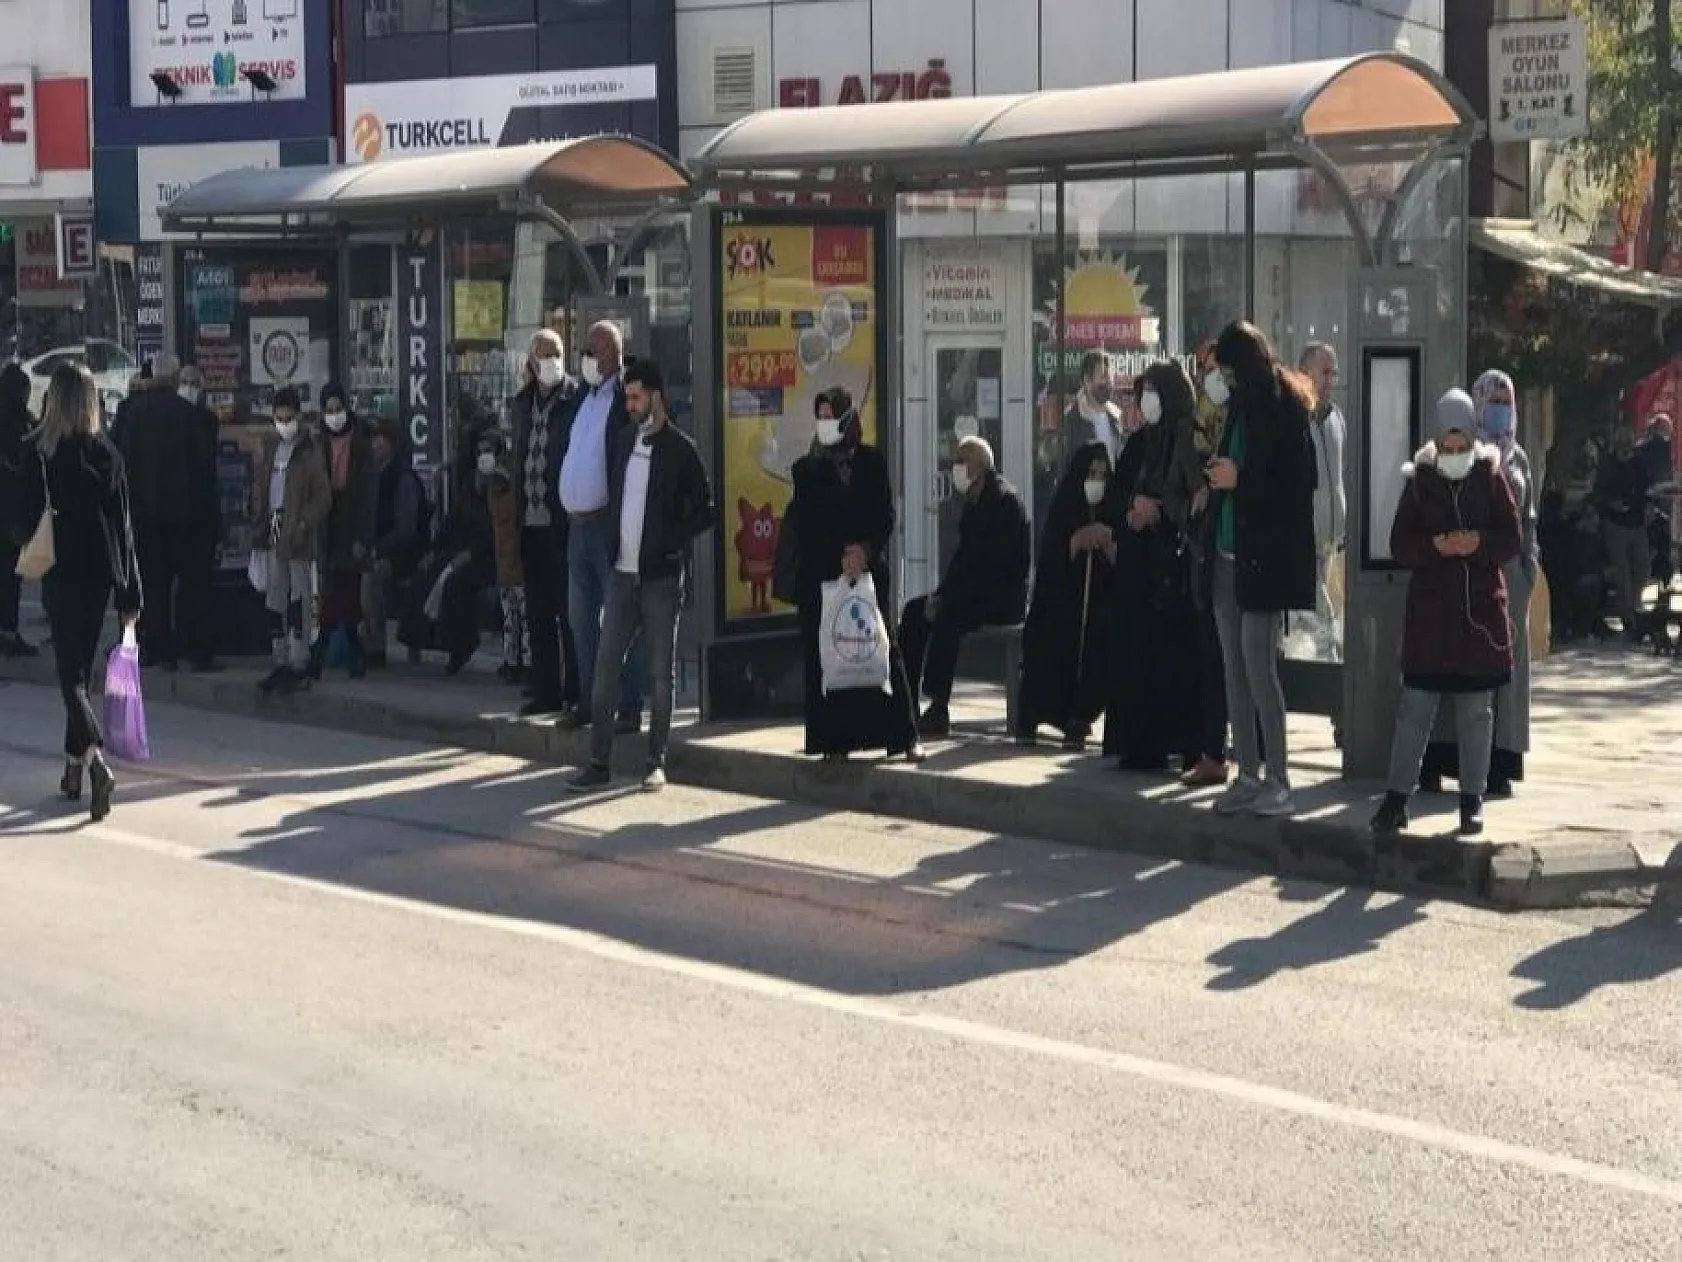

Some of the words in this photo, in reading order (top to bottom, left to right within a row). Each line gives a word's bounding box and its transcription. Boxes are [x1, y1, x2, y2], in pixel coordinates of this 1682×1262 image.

[1501, 33, 1570, 54] MERKEZ
[1512, 54, 1559, 74] OYUN
[1502, 73, 1570, 94] SALONU
[385, 118, 491, 149] TURKCELL
